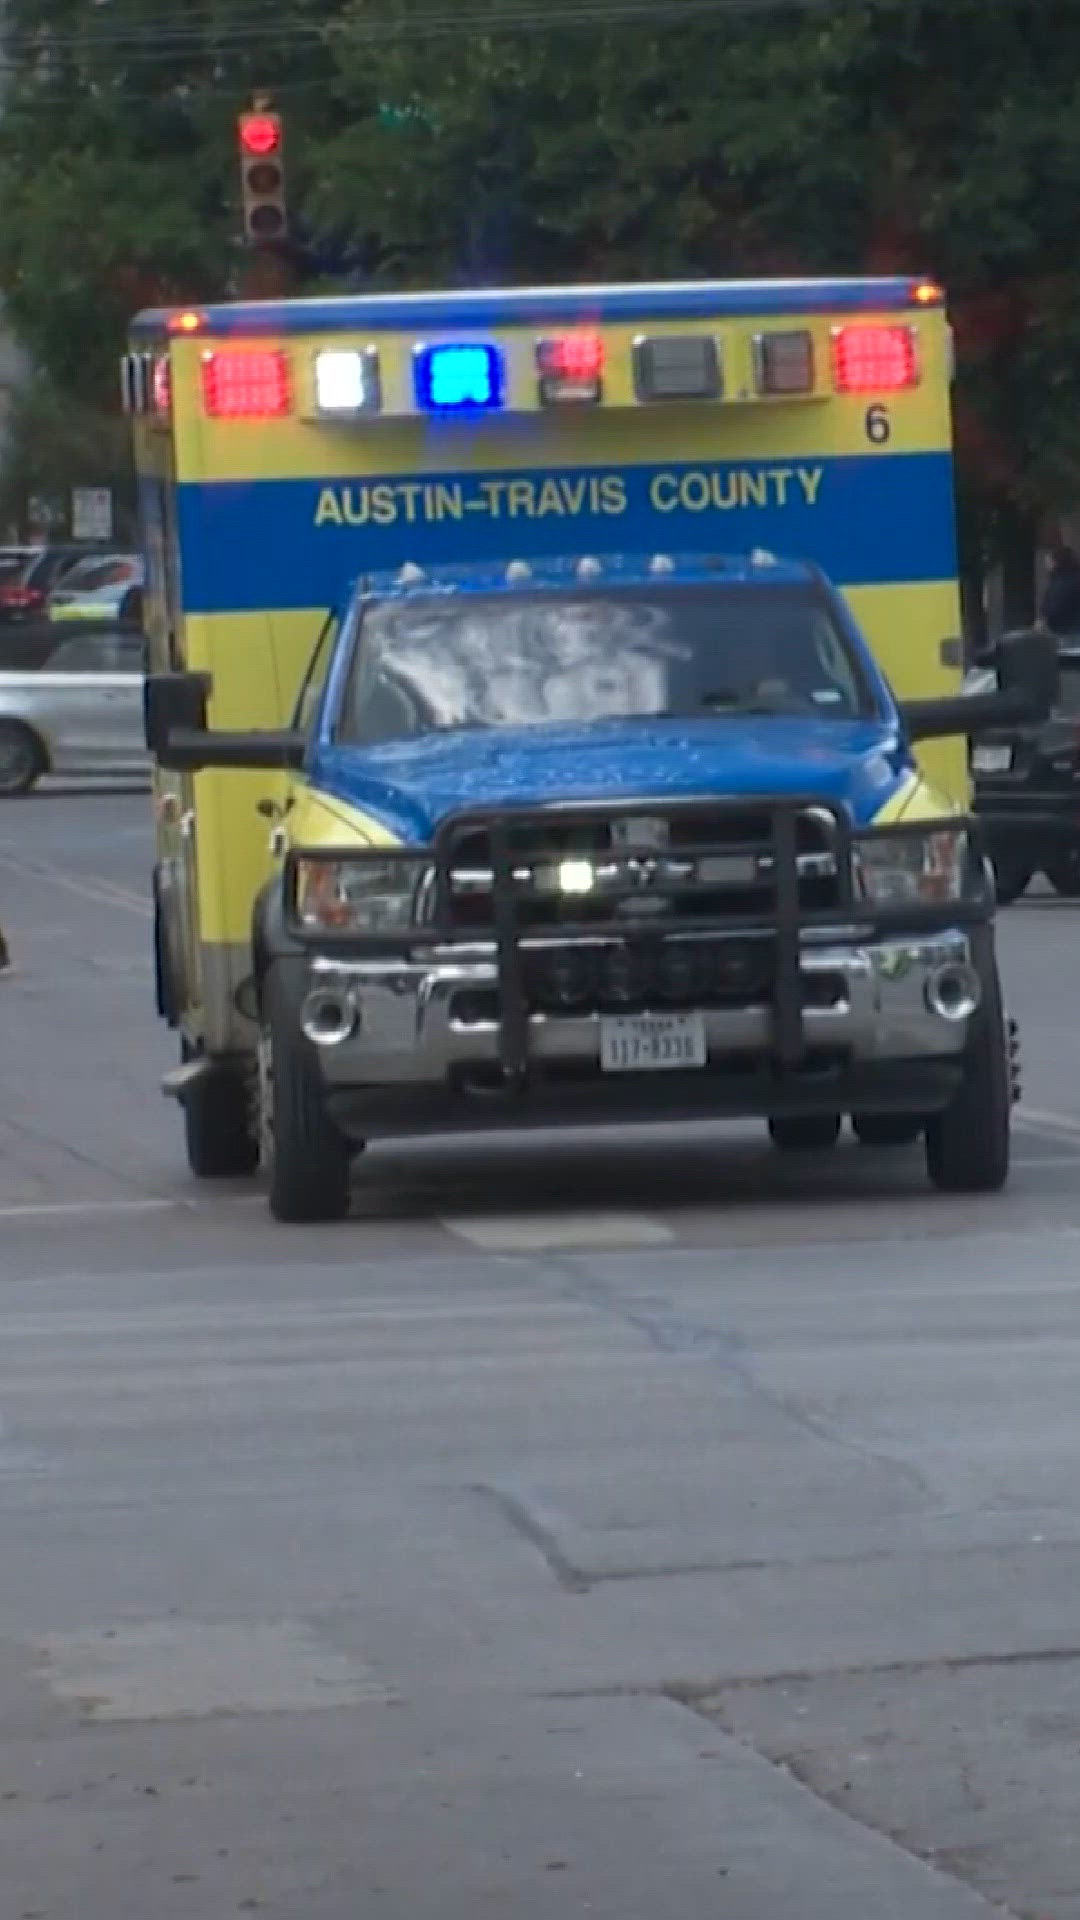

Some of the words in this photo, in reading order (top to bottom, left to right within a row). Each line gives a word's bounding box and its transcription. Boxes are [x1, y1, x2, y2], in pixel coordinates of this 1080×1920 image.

[865, 402, 891, 444] 6
[314, 475, 627, 527] AUSTIN-TRAVIS
[650, 465, 823, 512] COUNTY
